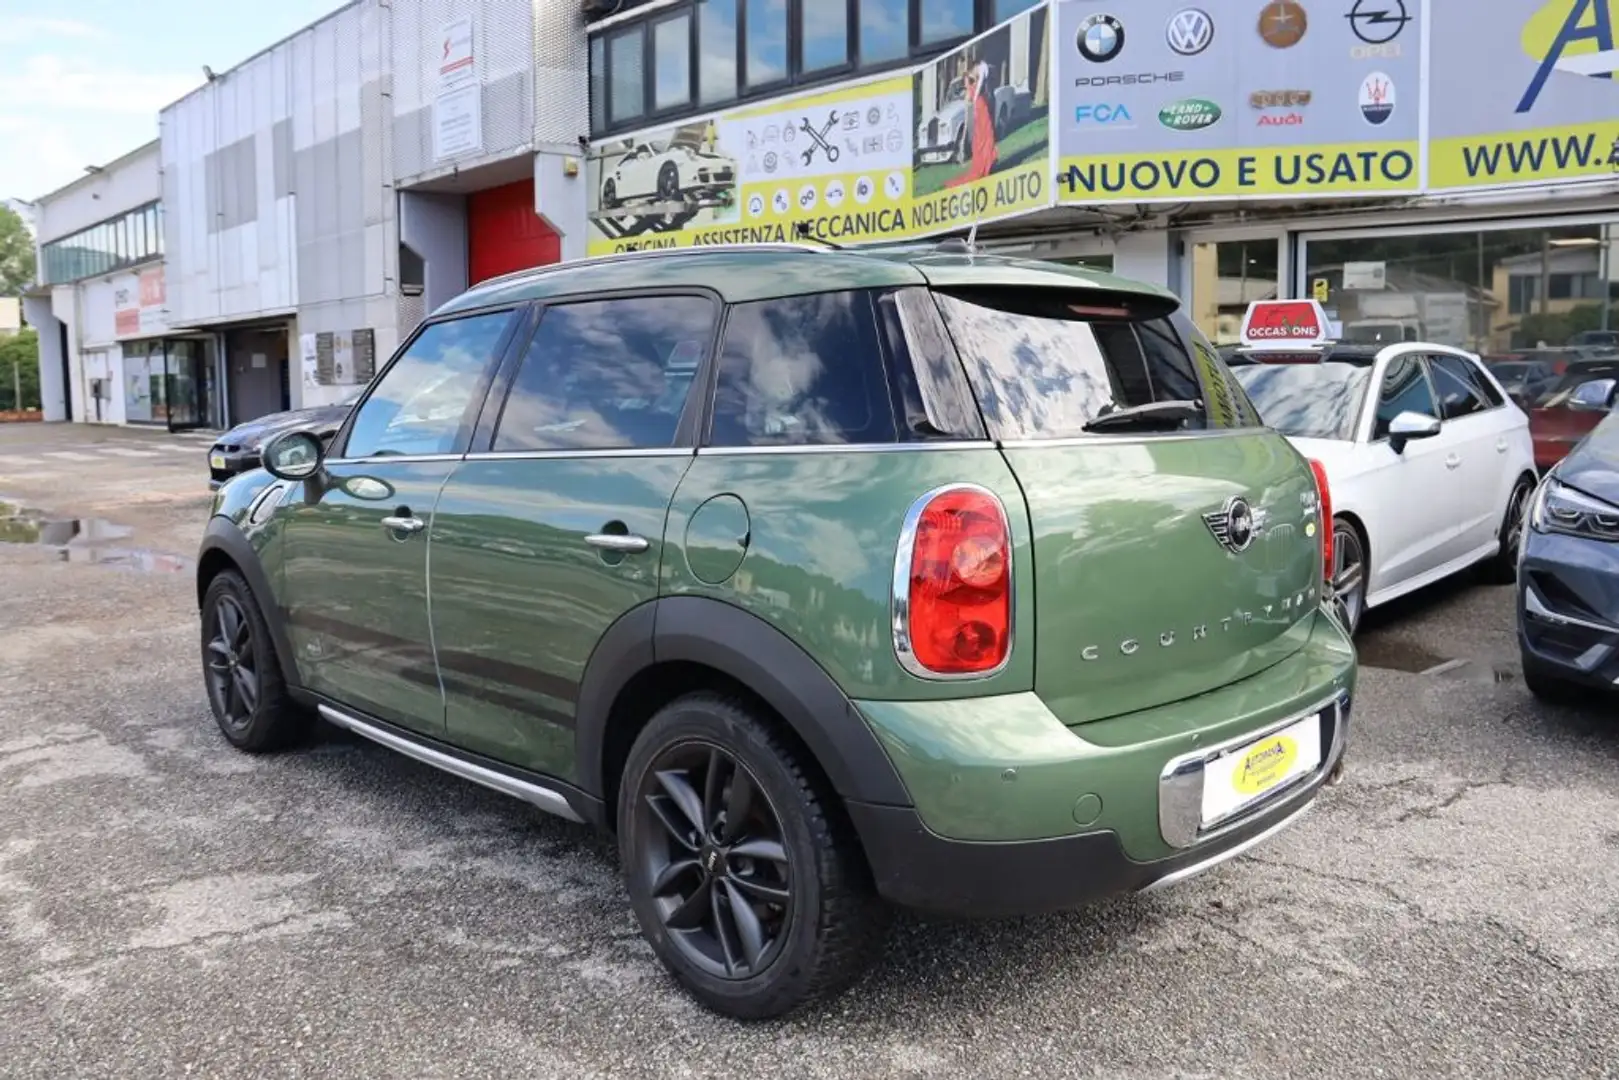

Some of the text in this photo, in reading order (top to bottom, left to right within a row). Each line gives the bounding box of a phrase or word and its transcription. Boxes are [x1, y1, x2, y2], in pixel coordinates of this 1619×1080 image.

[1351, 44, 1401, 59] OPEL
[1075, 71, 1184, 87] PORSCHE
[1075, 103, 1131, 124] FCA
[1170, 103, 1203, 115] LAND
[1173, 114, 1213, 125] ROVER
[1256, 112, 1304, 126] Audi
[1068, 149, 1413, 193] NUOVO E USATO
[911, 171, 1042, 229] NOLEGGIO AUTO
[692, 223, 786, 247] ASSISTENZA
